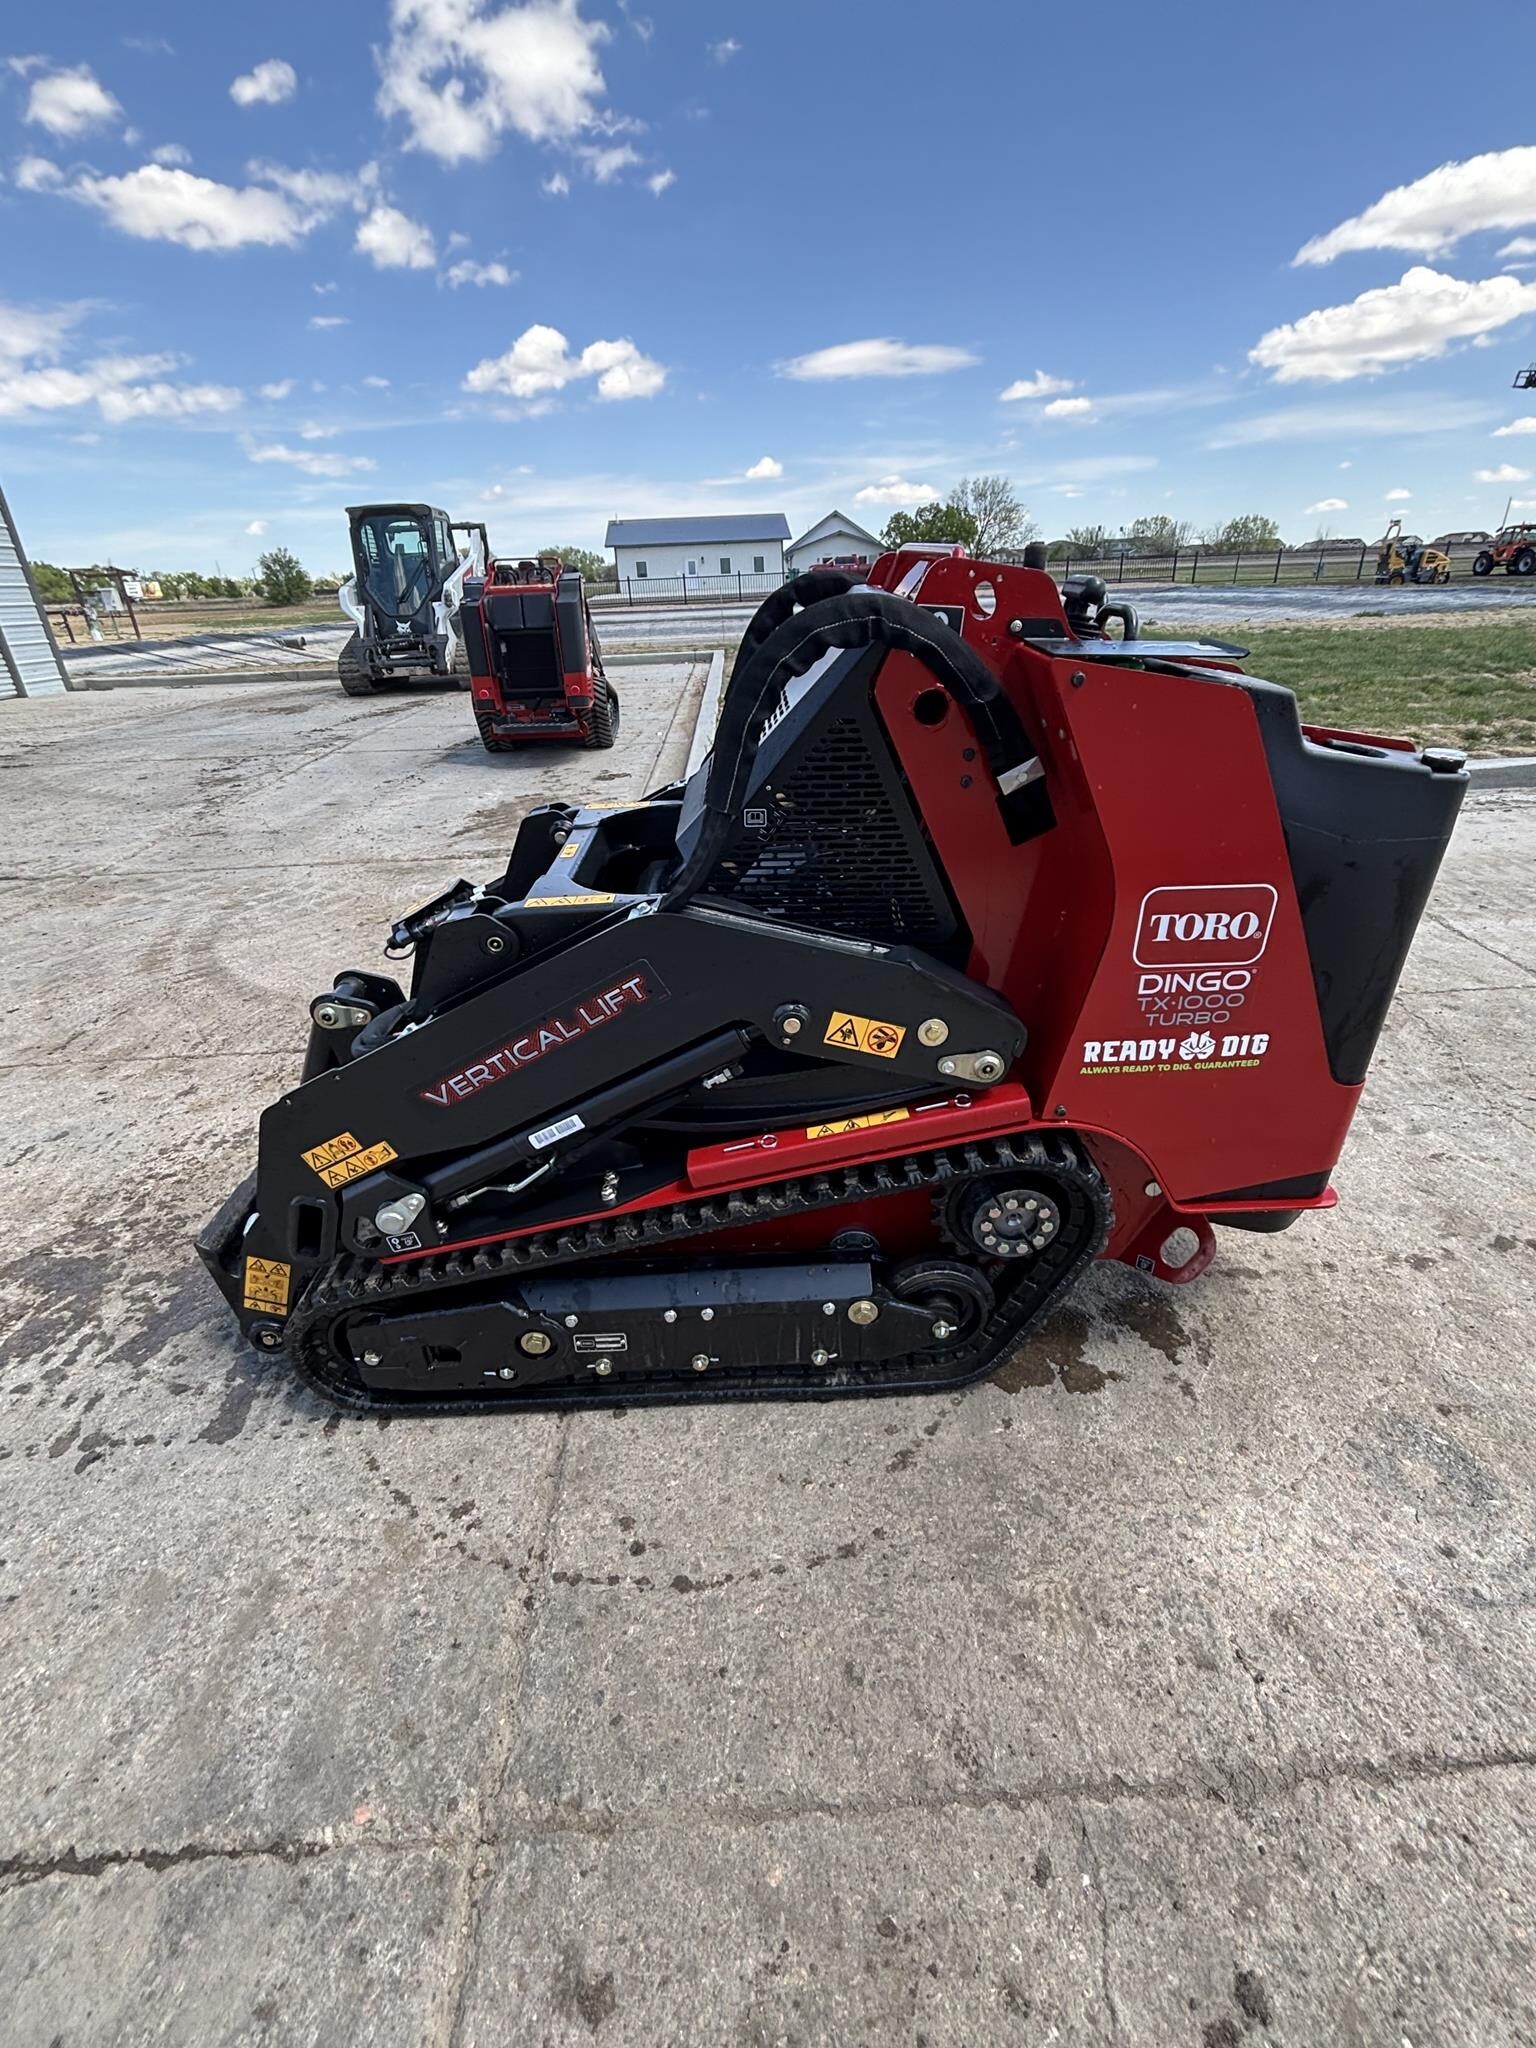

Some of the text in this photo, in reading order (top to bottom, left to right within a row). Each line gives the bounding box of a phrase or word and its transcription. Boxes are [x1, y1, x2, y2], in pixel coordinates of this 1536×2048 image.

[1138, 970, 1252, 994] DINGO
[1145, 1010, 1230, 1026] TURBO
[423, 976, 645, 1105] VERTICAL LIFT
[1083, 1033, 1270, 1063] READY DIG
[1080, 1066, 1120, 1075] ALWAYS
[1122, 1065, 1155, 1073] READY
[1158, 1064, 1170, 1072] TO
[1194, 1059, 1260, 1070] GUARANTEED
